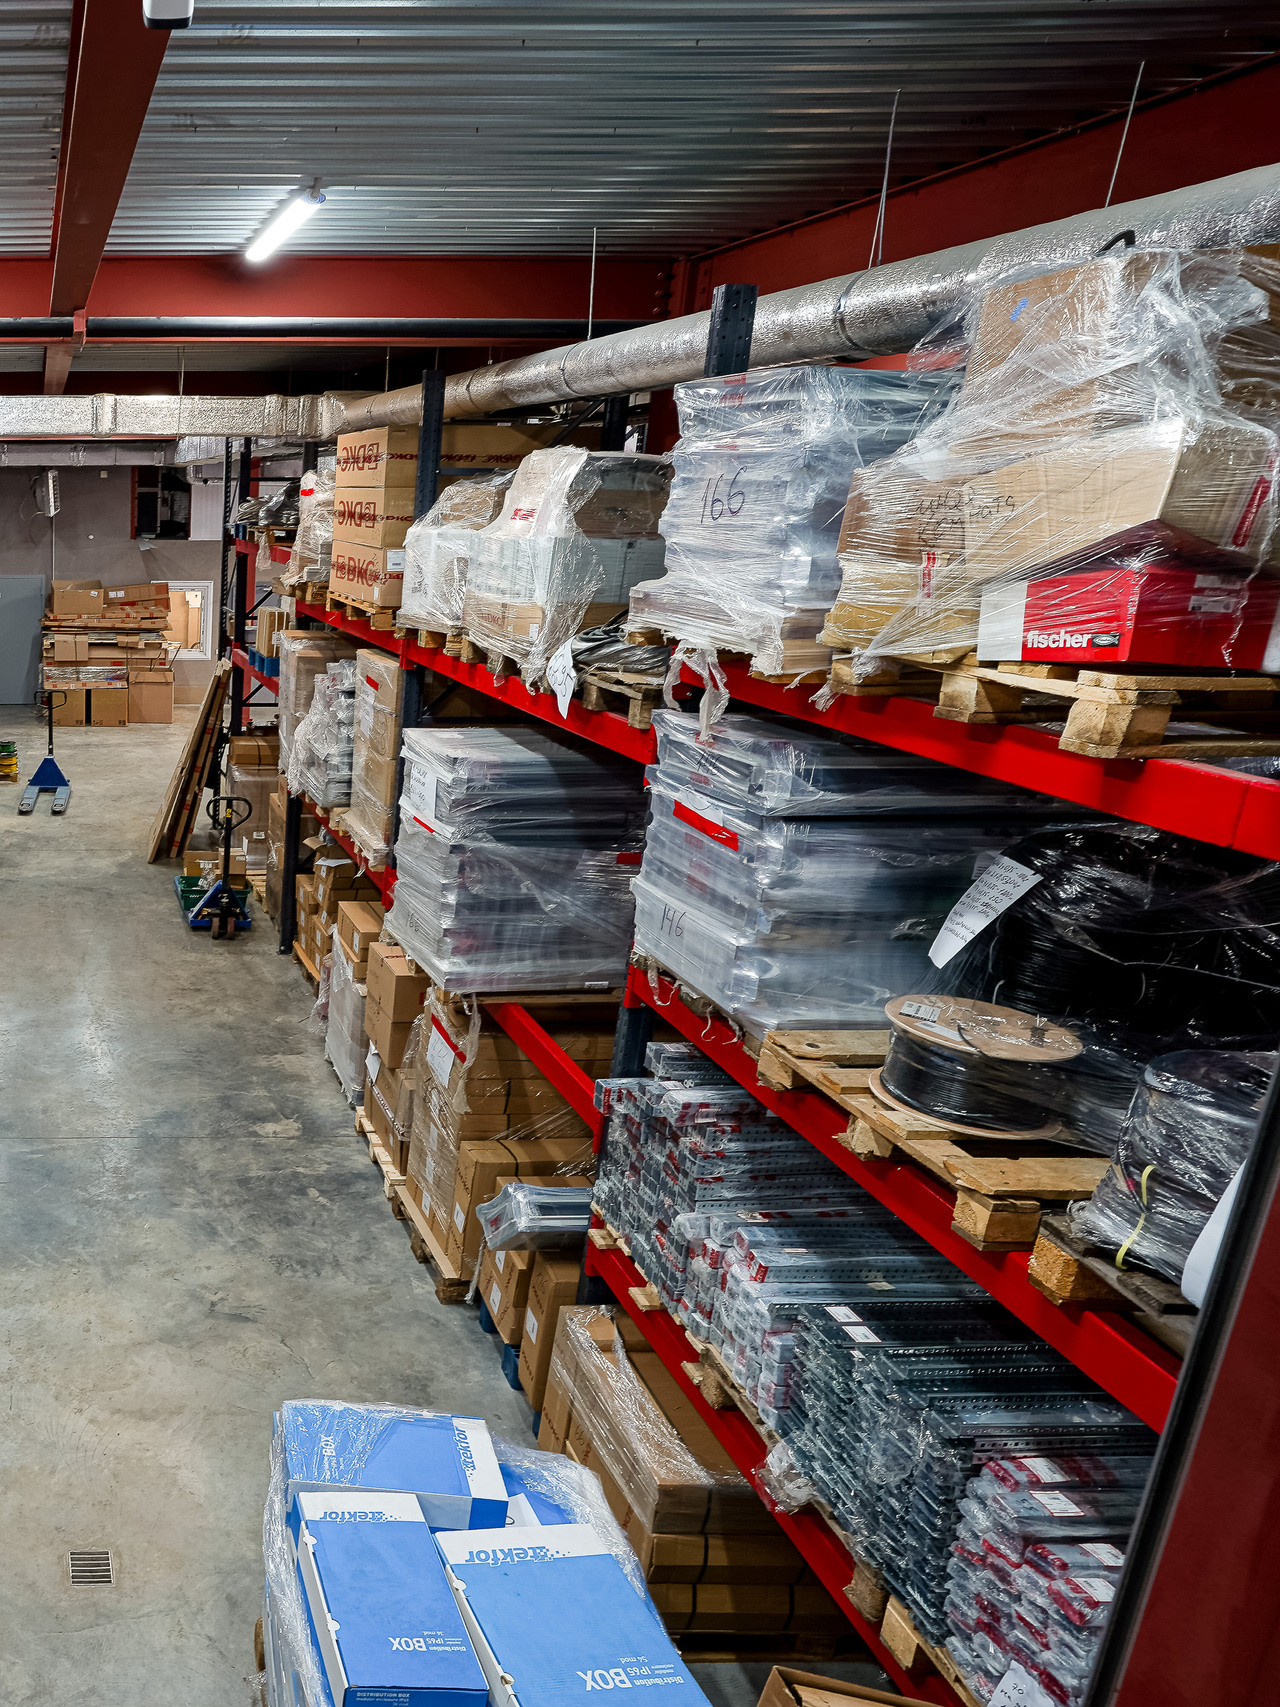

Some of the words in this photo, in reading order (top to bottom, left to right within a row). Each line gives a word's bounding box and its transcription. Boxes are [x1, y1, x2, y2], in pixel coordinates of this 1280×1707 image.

[341, 446, 367, 472] DKC
[701, 466, 747, 524] 166
[338, 500, 362, 527] DKC
[348, 557, 374, 587] DKC
[1026, 629, 1091, 648] fischer
[660, 903, 687, 937] 146
[321, 1433, 337, 1457] BOX
[454, 1426, 477, 1472] tekfor
[320, 1511, 384, 1524] tekfor
[466, 1546, 551, 1567] tekfor
[388, 1637, 427, 1652] BOX
[426, 1637, 445, 1645] IP65
[576, 1668, 632, 1691] BOX
[627, 1665, 652, 1677] IP65
[634, 1675, 685, 1687] Distribution
